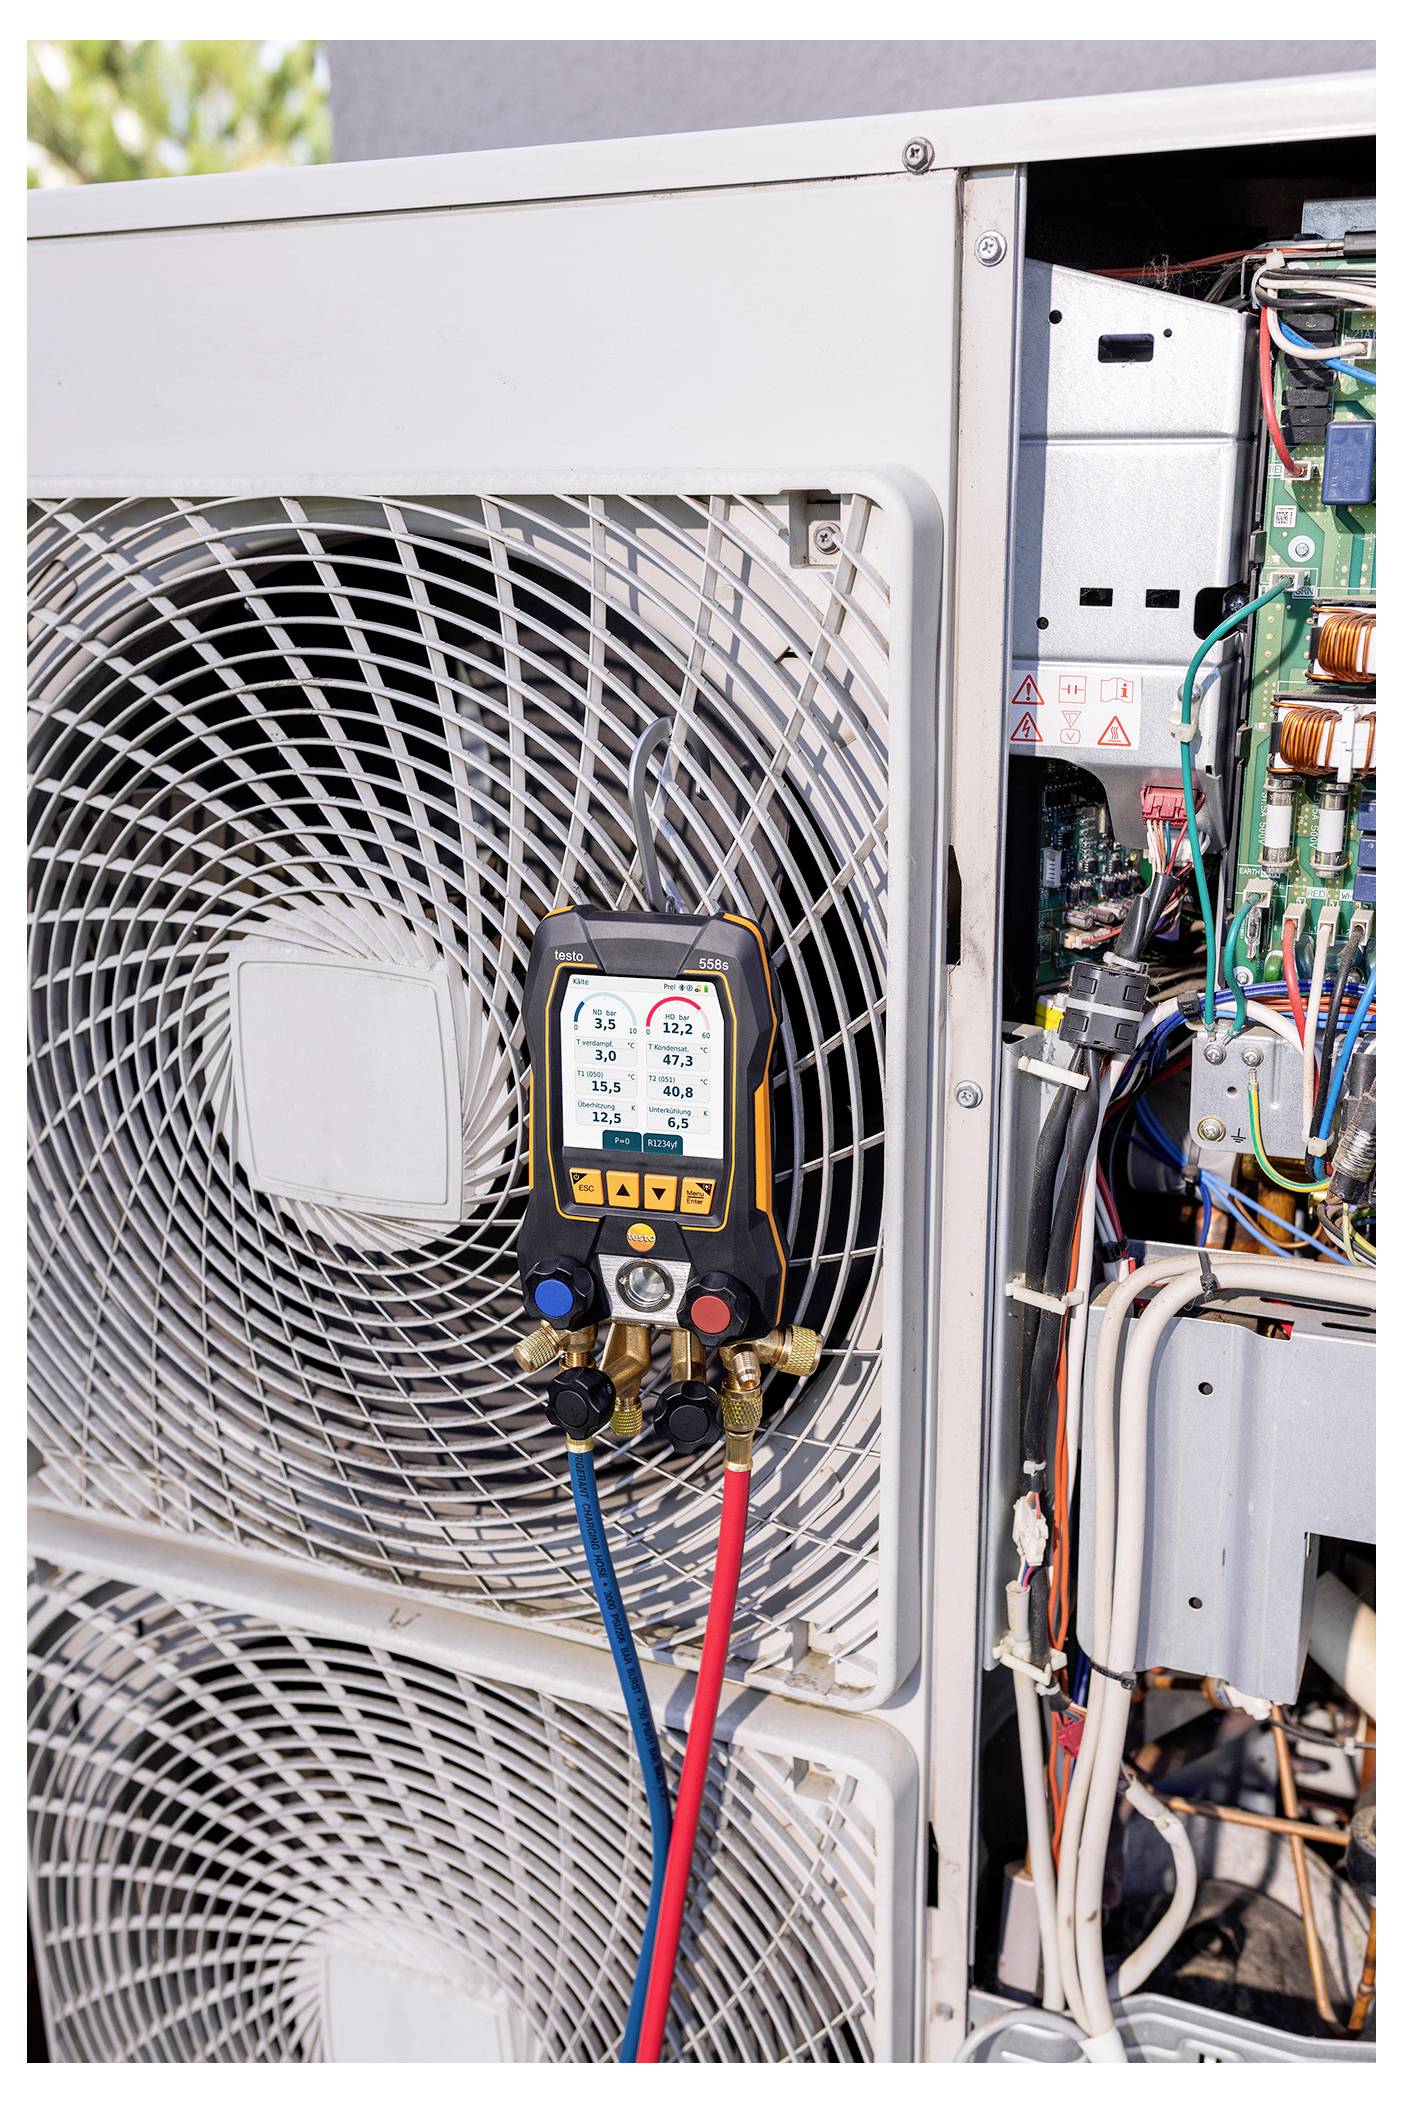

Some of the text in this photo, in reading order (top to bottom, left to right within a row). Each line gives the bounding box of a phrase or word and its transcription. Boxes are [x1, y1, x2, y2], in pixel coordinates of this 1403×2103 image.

[1310, 825, 1319, 849] 500V
[1239, 867, 1260, 876] EARTH
[1308, 890, 1326, 898] RED
[555, 950, 584, 961] testo
[699, 958, 729, 970] 558s
[572, 978, 589, 986] Kälte
[606, 1009, 616, 1017] bar
[594, 1018, 616, 1030] 3,5
[663, 1022, 693, 1035] 12,2
[582, 1039, 613, 1048] verdampf.
[654, 1044, 689, 1052] Kondensat.
[595, 1049, 616, 1062] 3,0
[663, 1054, 693, 1068] 47,3
[659, 1076, 676, 1084] (051)
[592, 1080, 621, 1093] 15,5
[663, 1086, 693, 1099] 40,8
[577, 1100, 615, 1111] Überhitzung
[649, 1106, 691, 1117] Unterkühlung
[592, 1112, 621, 1125] 12,5
[667, 1117, 689, 1130] 6,5
[648, 1140, 677, 1150] R1234yf
[627, 1231, 655, 1242] testo
[582, 1503, 600, 1550] CHARGING
[594, 1554, 608, 1579] HOSE
[621, 1647, 633, 1665] BAR
